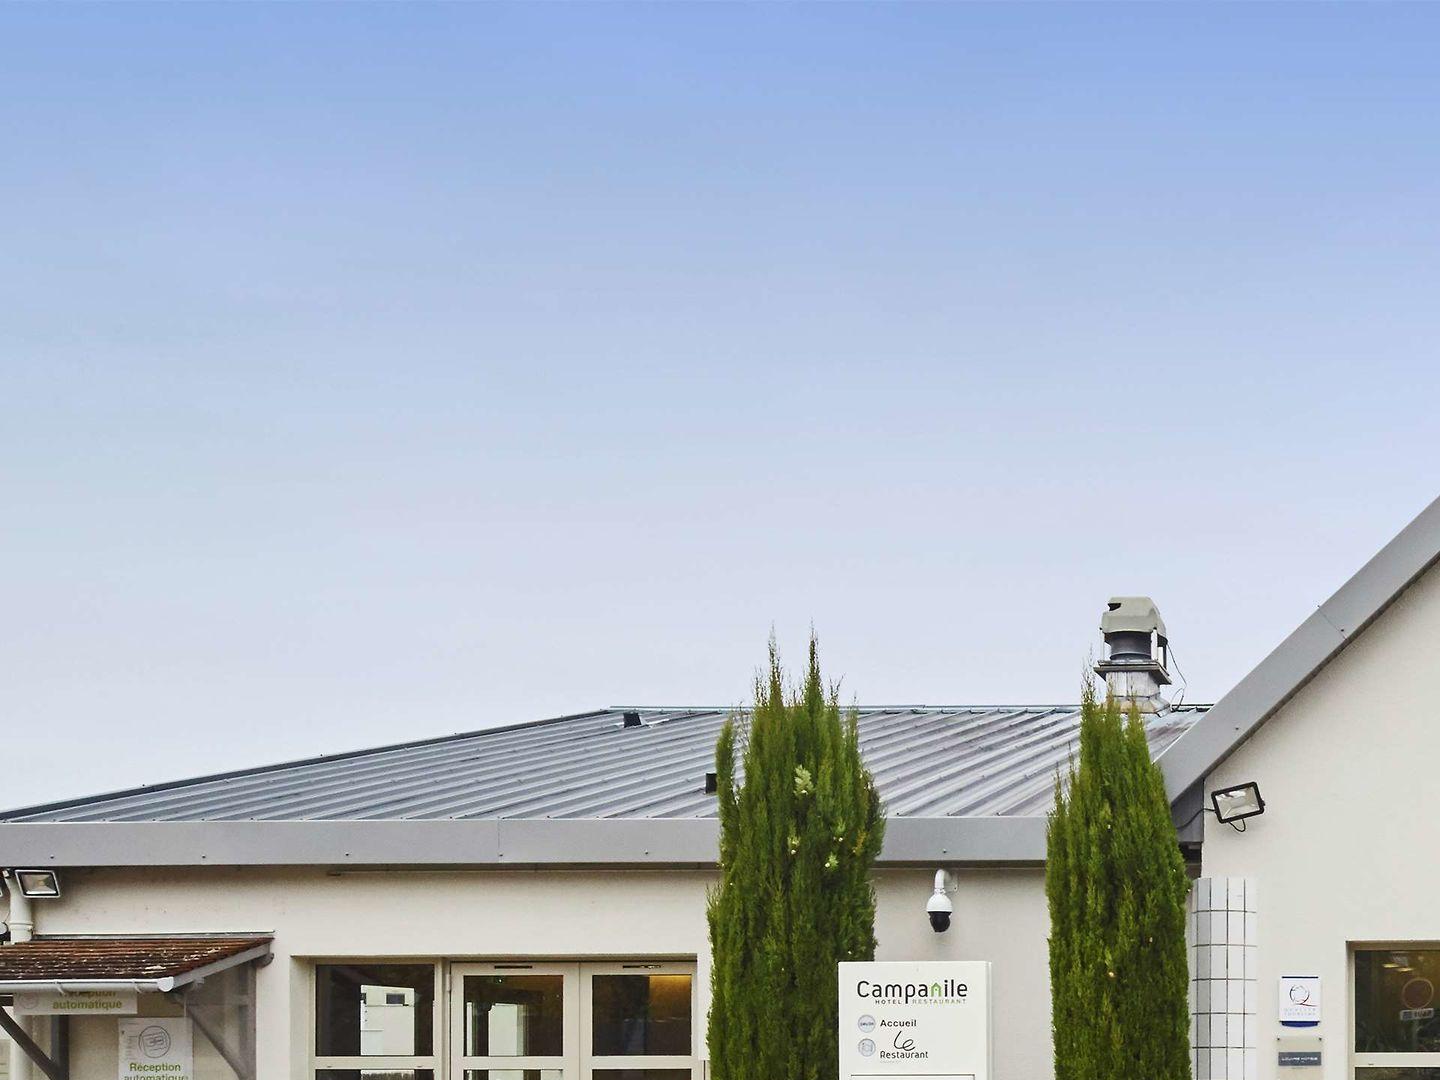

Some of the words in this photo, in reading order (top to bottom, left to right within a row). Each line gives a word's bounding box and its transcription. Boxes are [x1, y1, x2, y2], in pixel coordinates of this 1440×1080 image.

[857, 979, 968, 1005] Campanile
[880, 1019, 917, 1027] Accueil
[880, 1050, 928, 1059] Restaurant
